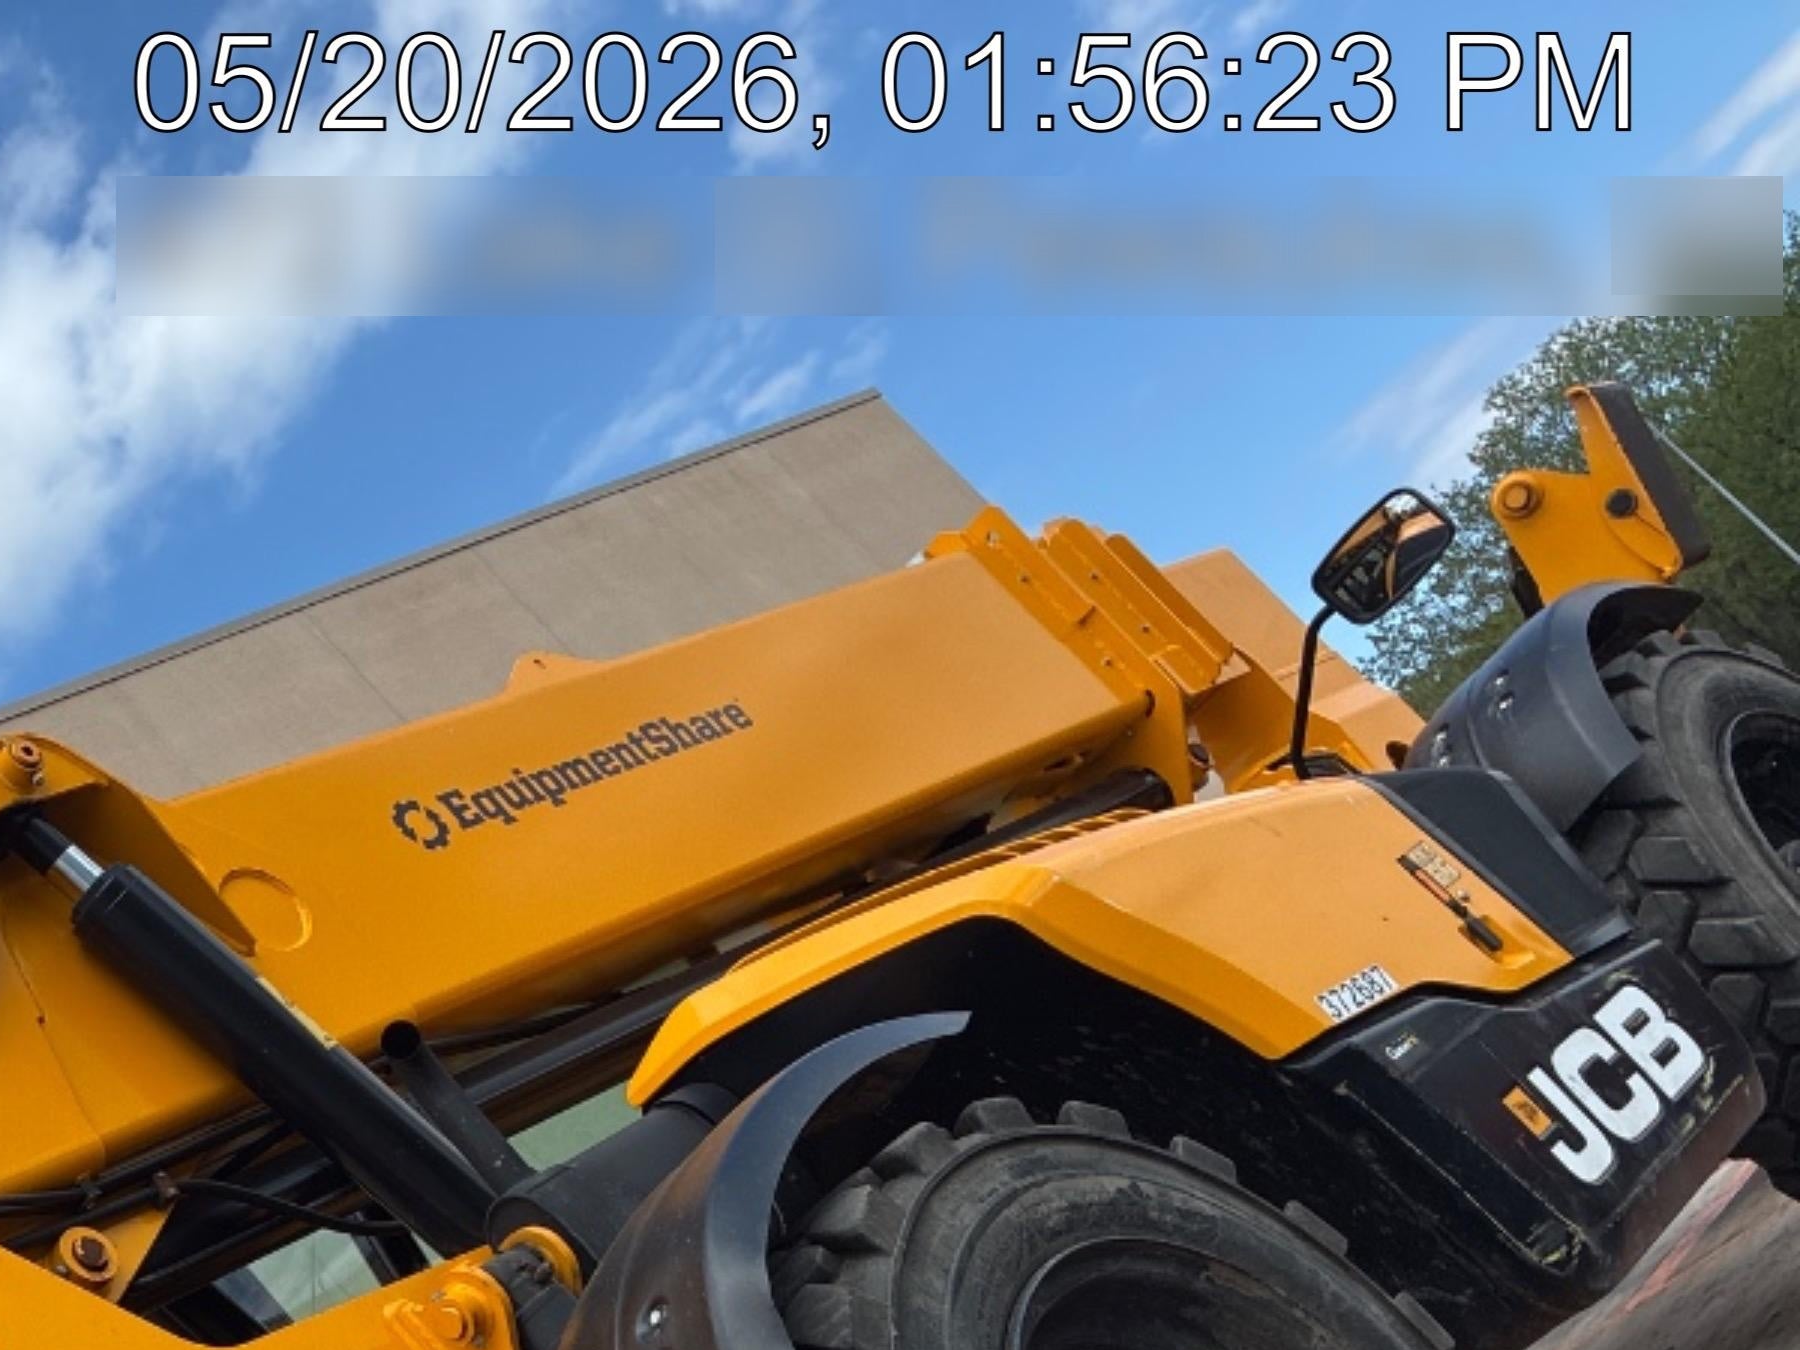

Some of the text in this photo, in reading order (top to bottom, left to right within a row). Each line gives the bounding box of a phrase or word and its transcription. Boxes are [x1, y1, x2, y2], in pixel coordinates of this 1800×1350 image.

[436, 703, 753, 825] EquipmentShare
[1317, 964, 1394, 1018] 372687
[1526, 985, 1706, 1186] JCB
